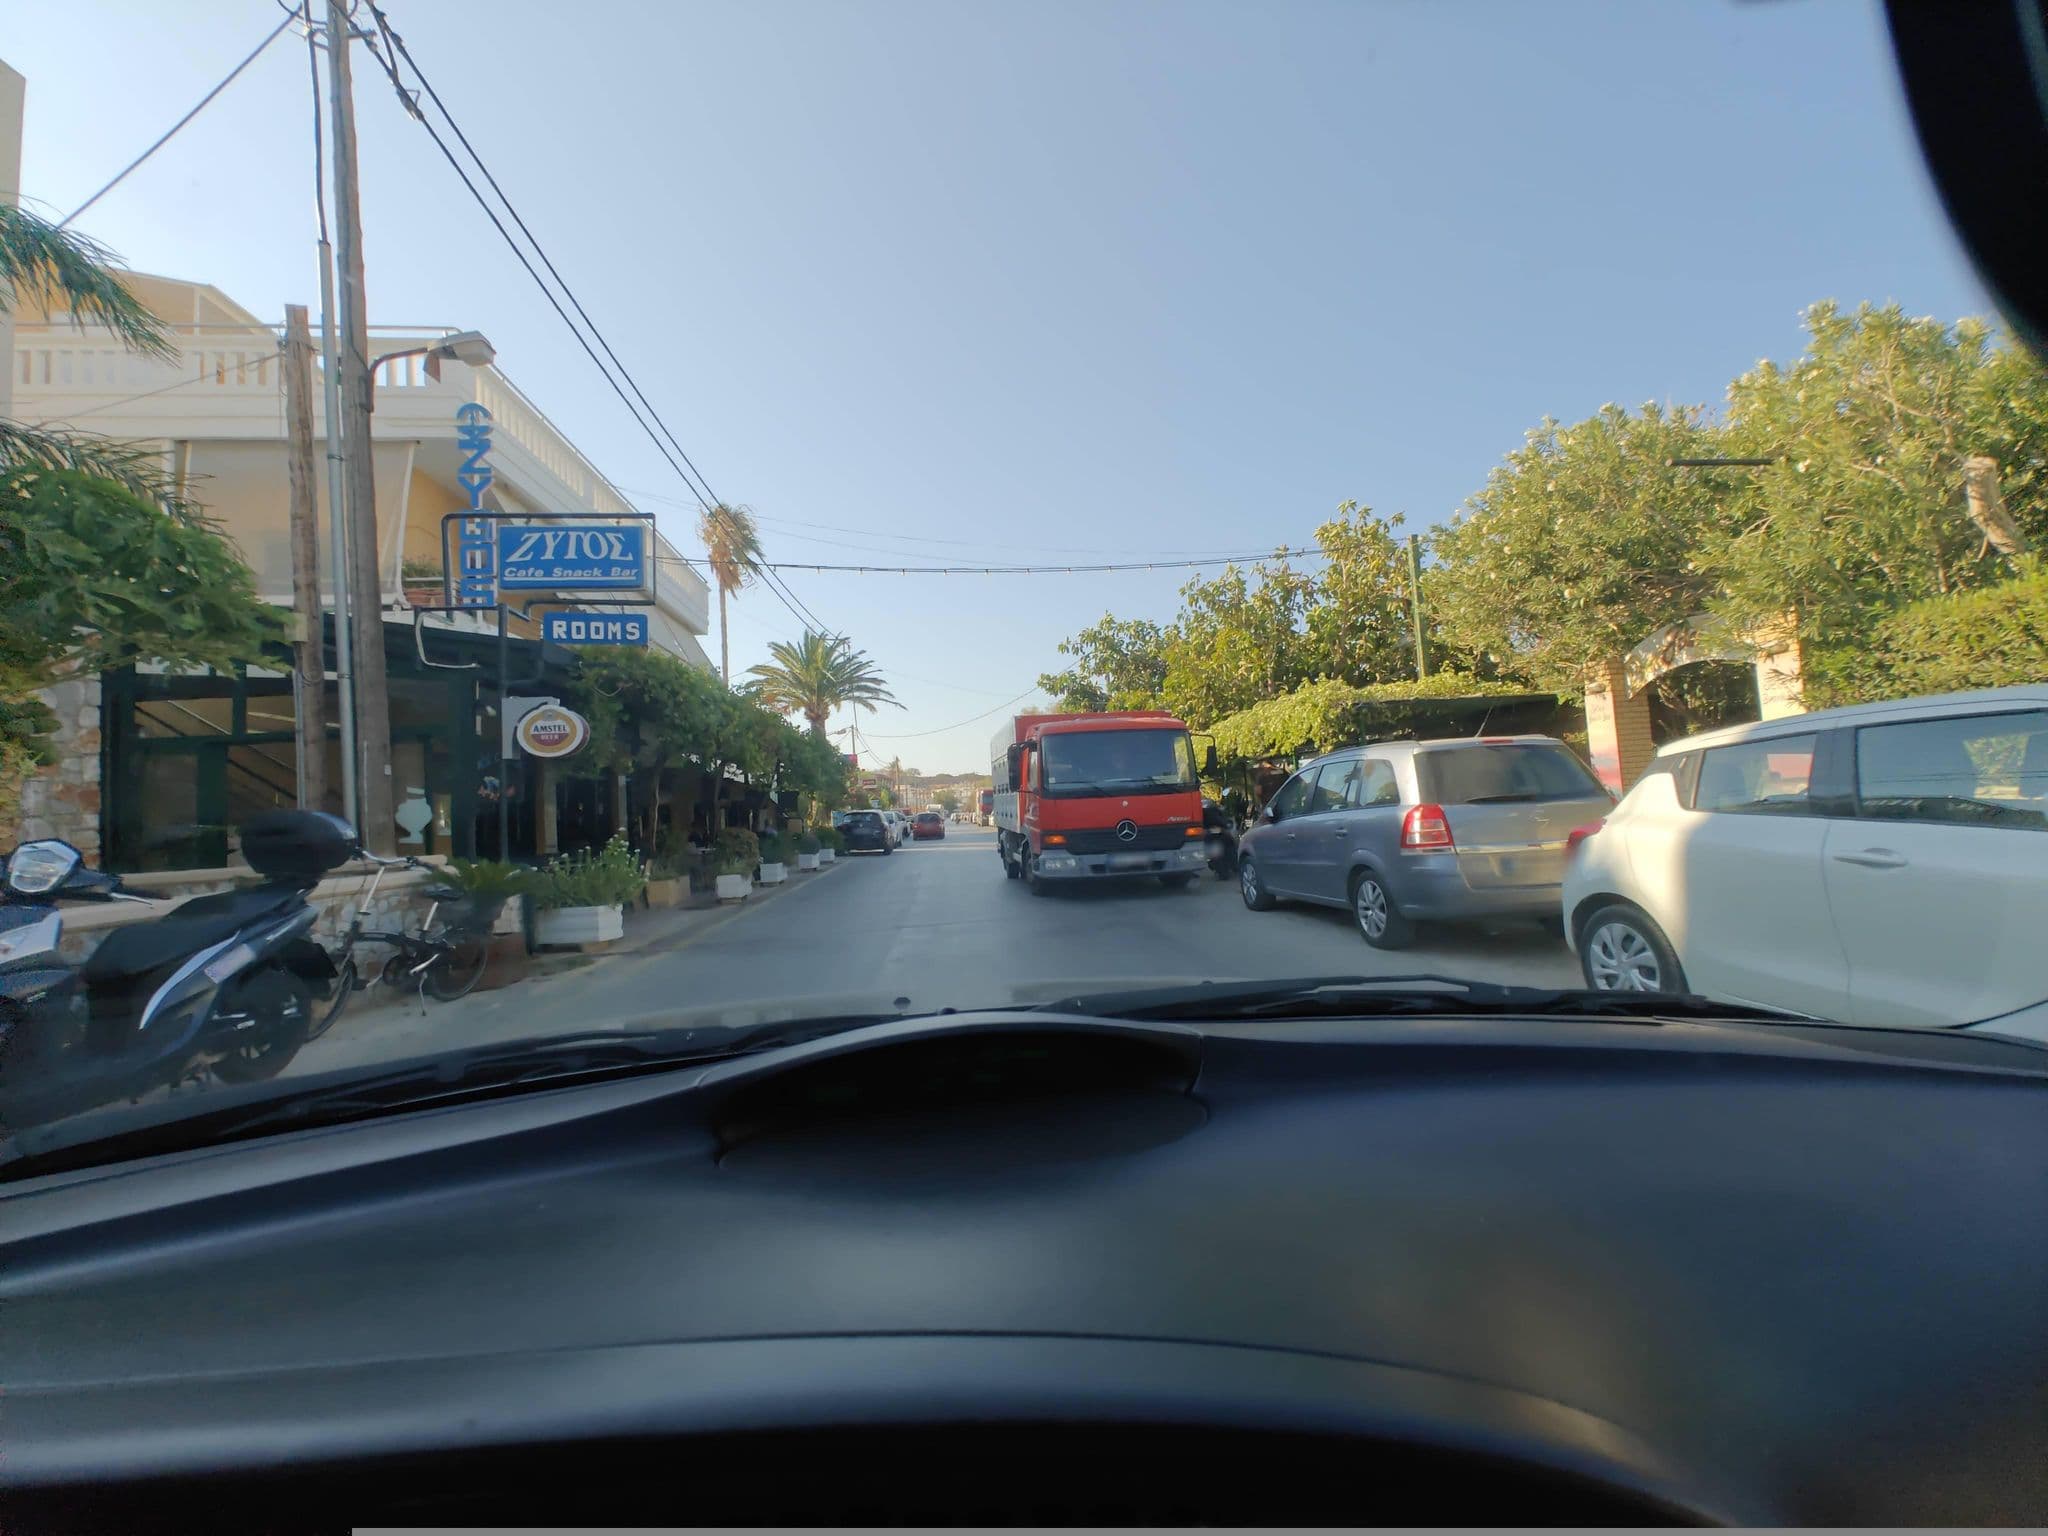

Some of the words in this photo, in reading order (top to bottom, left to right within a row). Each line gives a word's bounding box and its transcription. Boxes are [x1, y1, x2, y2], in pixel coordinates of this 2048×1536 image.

[504, 567, 544, 577] Cafe
[552, 567, 602, 577] Snack
[611, 567, 639, 577] Bar
[552, 620, 640, 640] ROOMS
[533, 724, 567, 732] AMSTEL
